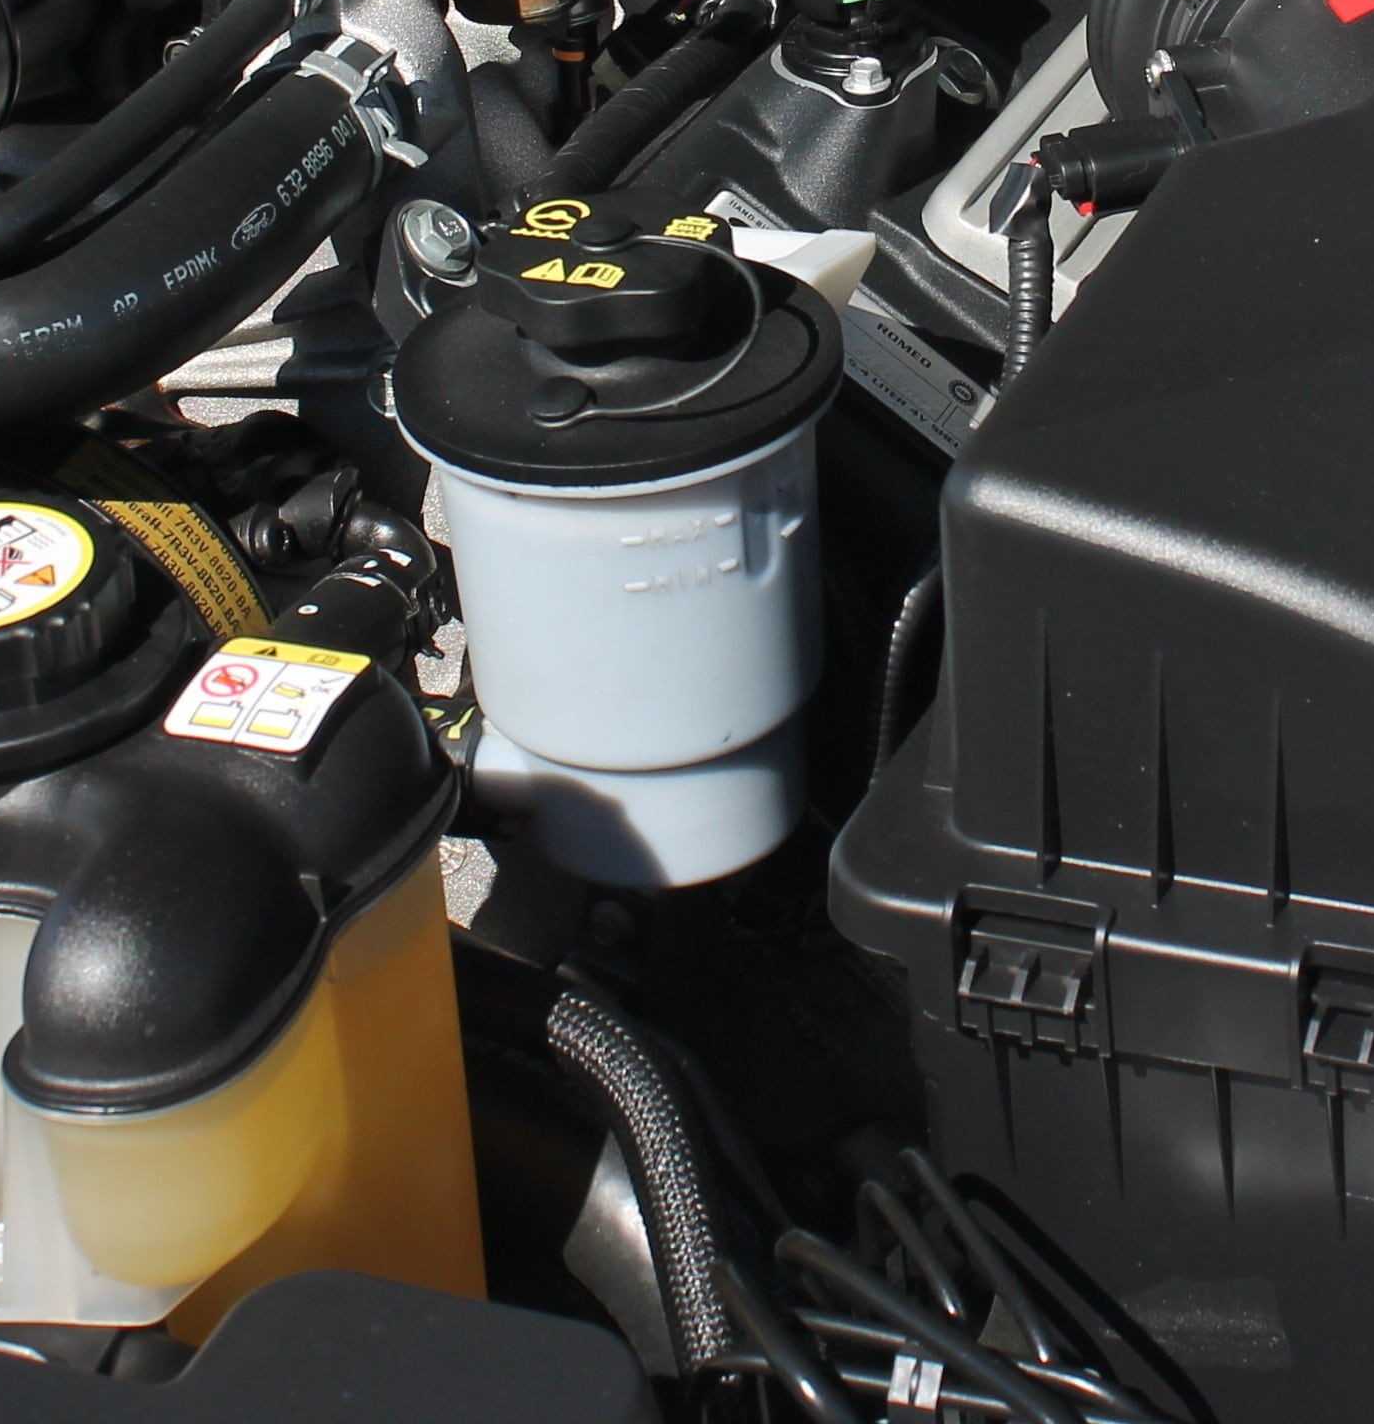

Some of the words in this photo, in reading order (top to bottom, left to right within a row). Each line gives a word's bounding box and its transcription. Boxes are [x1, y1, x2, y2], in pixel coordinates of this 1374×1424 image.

[301, 137, 334, 179] 8896
[330, 114, 357, 148] 041
[876, 322, 933, 369] ROMEO
[871, 377, 908, 409] LITER
[930, 422, 964, 451] SHEL
[175, 514, 252, 620] 7R3V-8620-BA
